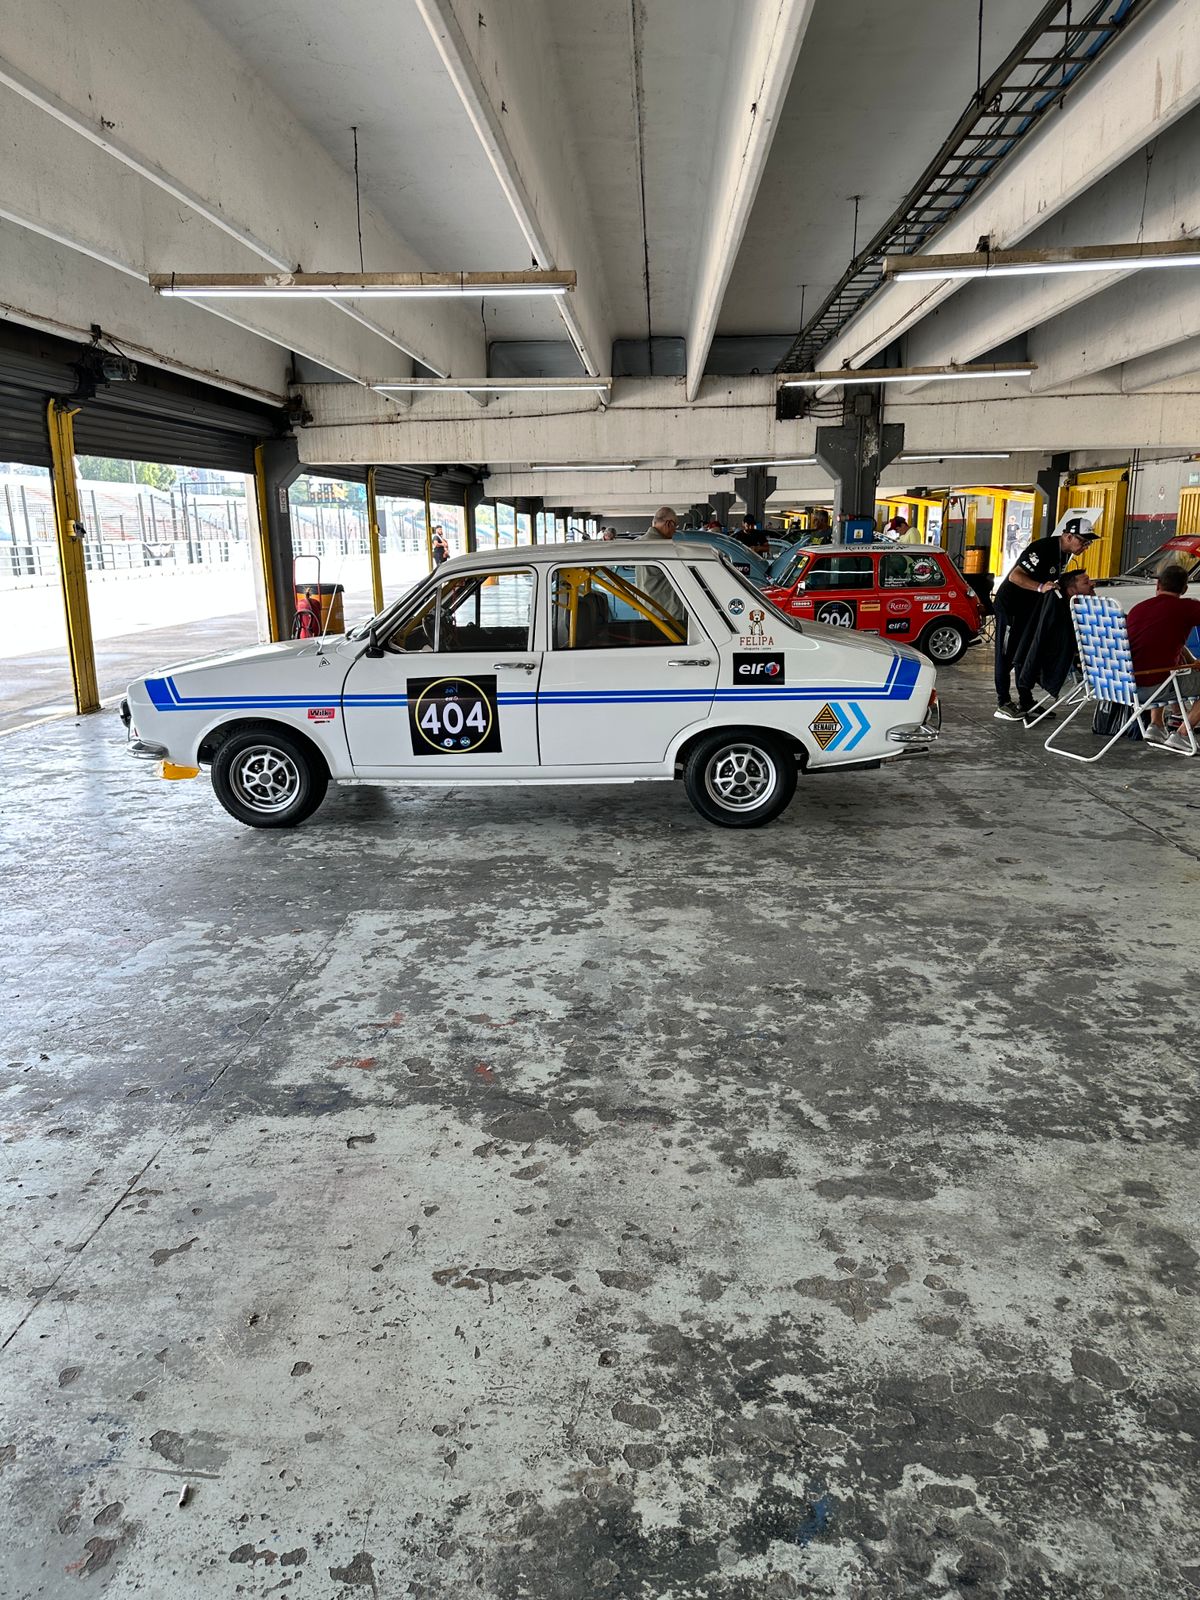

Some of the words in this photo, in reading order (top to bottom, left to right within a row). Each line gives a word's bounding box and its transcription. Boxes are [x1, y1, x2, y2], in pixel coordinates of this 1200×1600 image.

[890, 602, 909, 611] Retro
[821, 612, 850, 629] 204
[888, 622, 901, 630] elf
[739, 636, 774, 646] FELIPA
[738, 663, 765, 675] elf
[420, 701, 487, 735] 404
[813, 723, 837, 731] RENAULT
